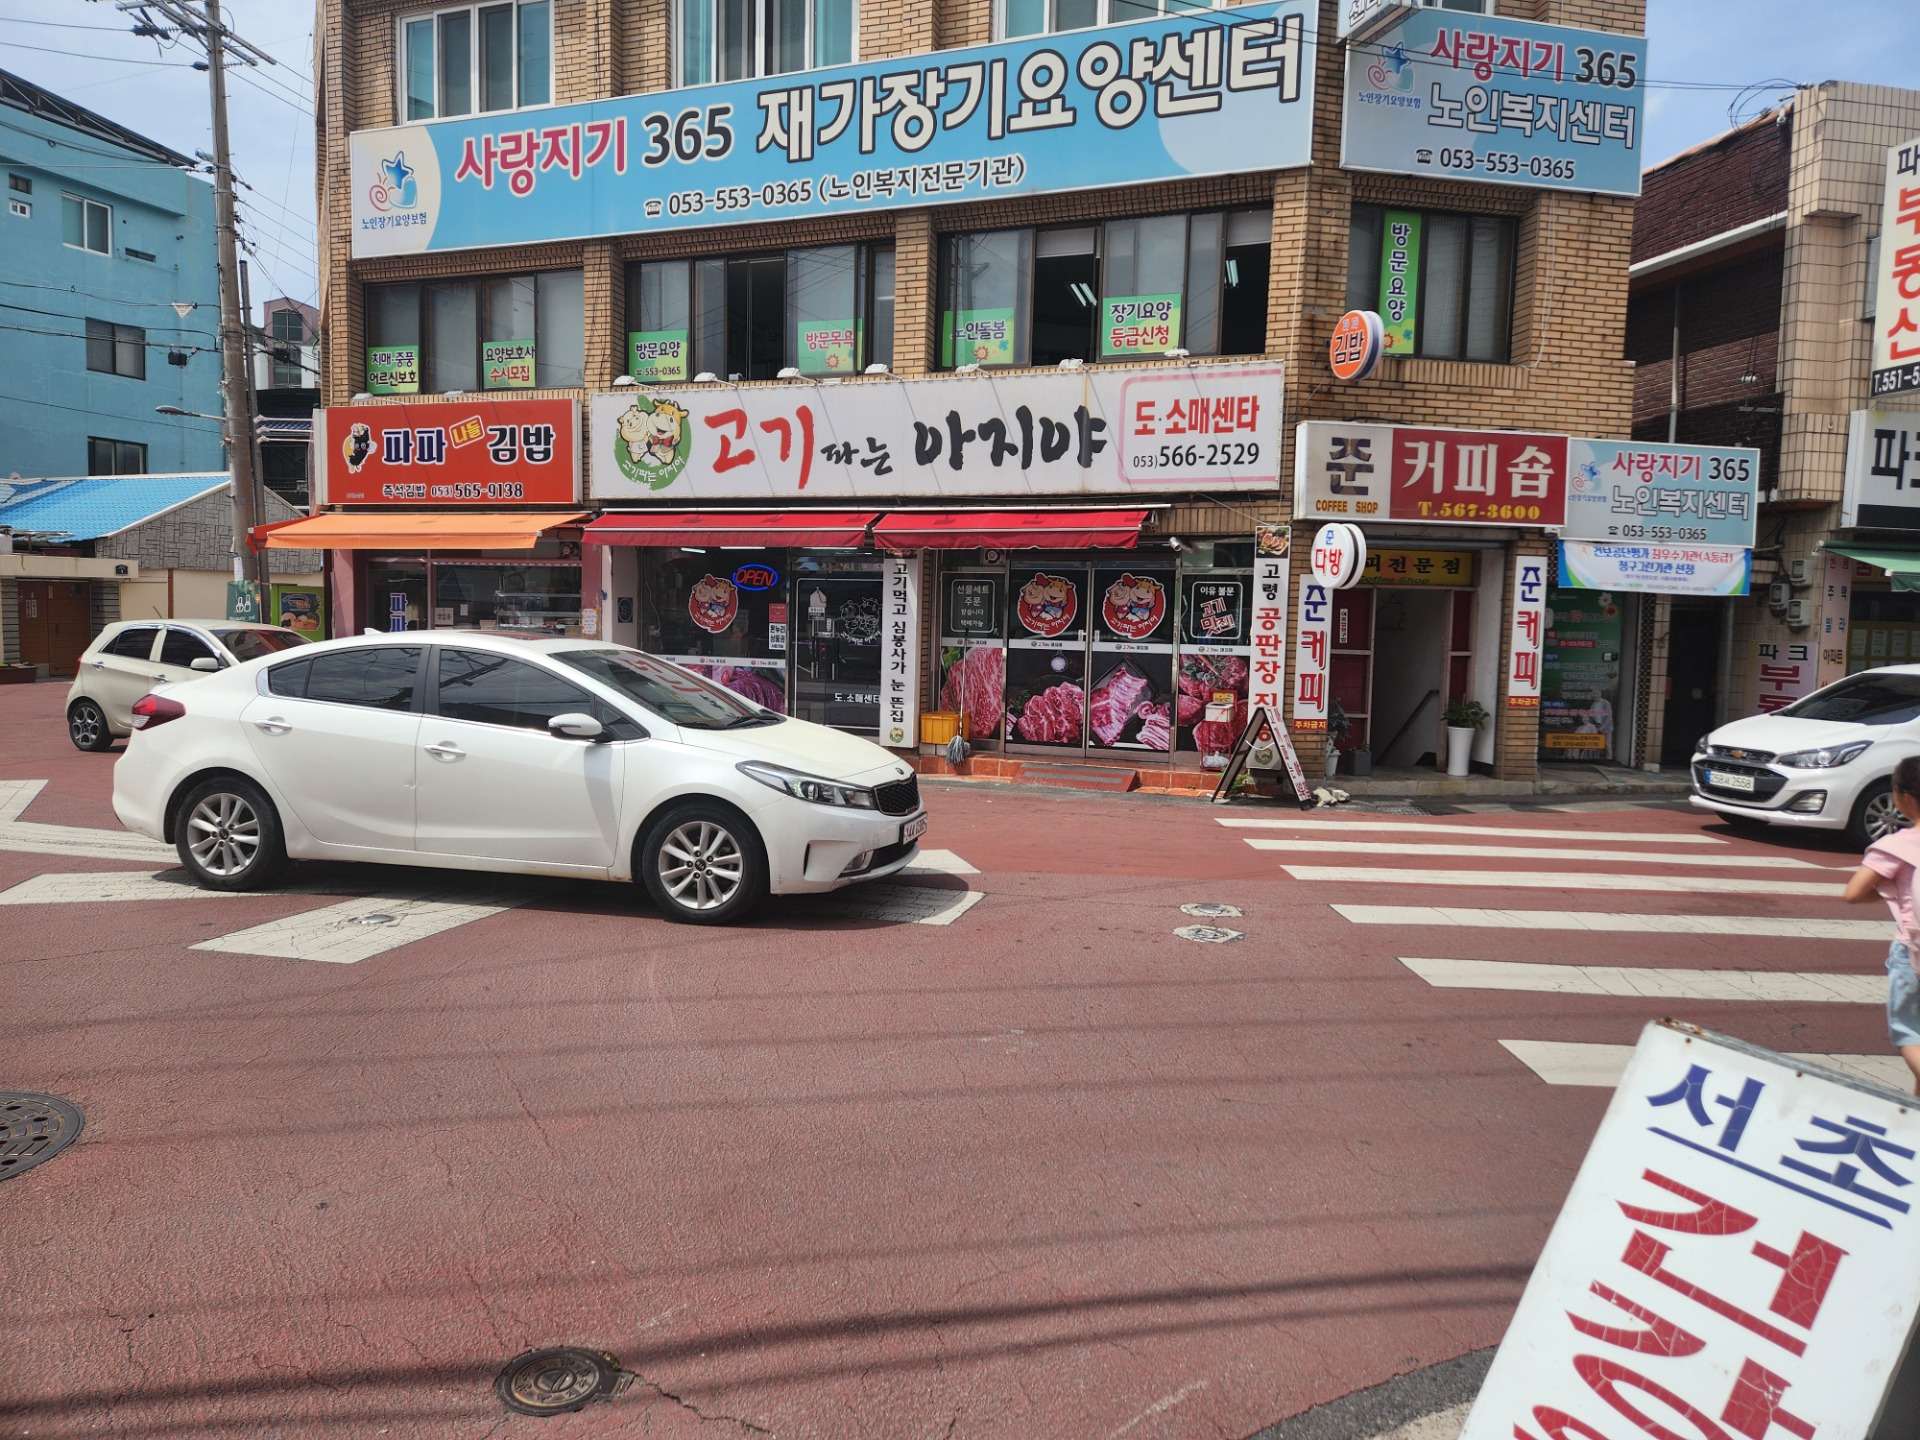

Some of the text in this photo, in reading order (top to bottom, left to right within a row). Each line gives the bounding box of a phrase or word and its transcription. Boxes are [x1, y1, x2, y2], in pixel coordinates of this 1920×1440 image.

[1430, 28, 1637, 88] 사랑지기 365
[455, 13, 1303, 197] 사랑지기 365 재가장기요양센터
[1358, 91, 1422, 109] 노인장기요양보험
[1427, 82, 1635, 149] 노인복지센터
[1439, 147, 1575, 180] 053-553-0365
[668, 153, 1026, 216] 053-553-0365 (노인복지전문기관)
[361, 211, 427, 231] 노인장기요양보험
[1387, 223, 1412, 324] 방문요양
[1110, 300, 1172, 324] 장기요양
[805, 329, 854, 351] 방문목욕
[1109, 324, 1170, 349] 등급신청
[1334, 330, 1365, 366] 김밥
[484, 345, 535, 363] 요양보호사
[635, 340, 681, 361] 방문요양
[369, 370, 418, 387] 어르신보호
[490, 365, 529, 383] 수시모집
[644, 366, 681, 377] 553-0365
[1874, 366, 1920, 393] T.551-5
[382, 428, 447, 465] 파파
[487, 424, 556, 465] 김밥
[704, 405, 1107, 489] 고기 파는 아지야
[1326, 437, 1555, 499] 준 커피숍
[1612, 452, 1750, 483] 사랑지기 365
[383, 483, 427, 498] 즉석김밥
[1316, 500, 1379, 514] COFFEE SHOP
[1418, 500, 1541, 521] T.567-3600
[1611, 485, 1749, 521] 노인복지센터
[1325, 530, 1335, 545] 준
[1622, 524, 1707, 541] 053-553-0365
[1315, 548, 1344, 577] 다방
[736, 568, 774, 587] OPEN
[1262, 563, 1280, 601] 고령
[891, 563, 908, 616] 고기먹고
[956, 584, 990, 595] 선물세트
[1200, 586, 1235, 596] 이유 불문
[964, 597, 982, 607] 주문
[1200, 597, 1227, 617] 고기
[770, 624, 786, 634] 온누리
[960, 619, 984, 628] 택배가능
[1513, 566, 1543, 690] 준 커피
[1254, 607, 1282, 684] 공판장
[1298, 585, 1329, 712] 준 커피
[1758, 644, 1808, 661] 파크
[1509, 697, 1540, 706] 주차금지
[1295, 719, 1327, 731] 주차금지
[1646, 1063, 1916, 1214] 서초
[1514, 1168, 1850, 1440] 건강
